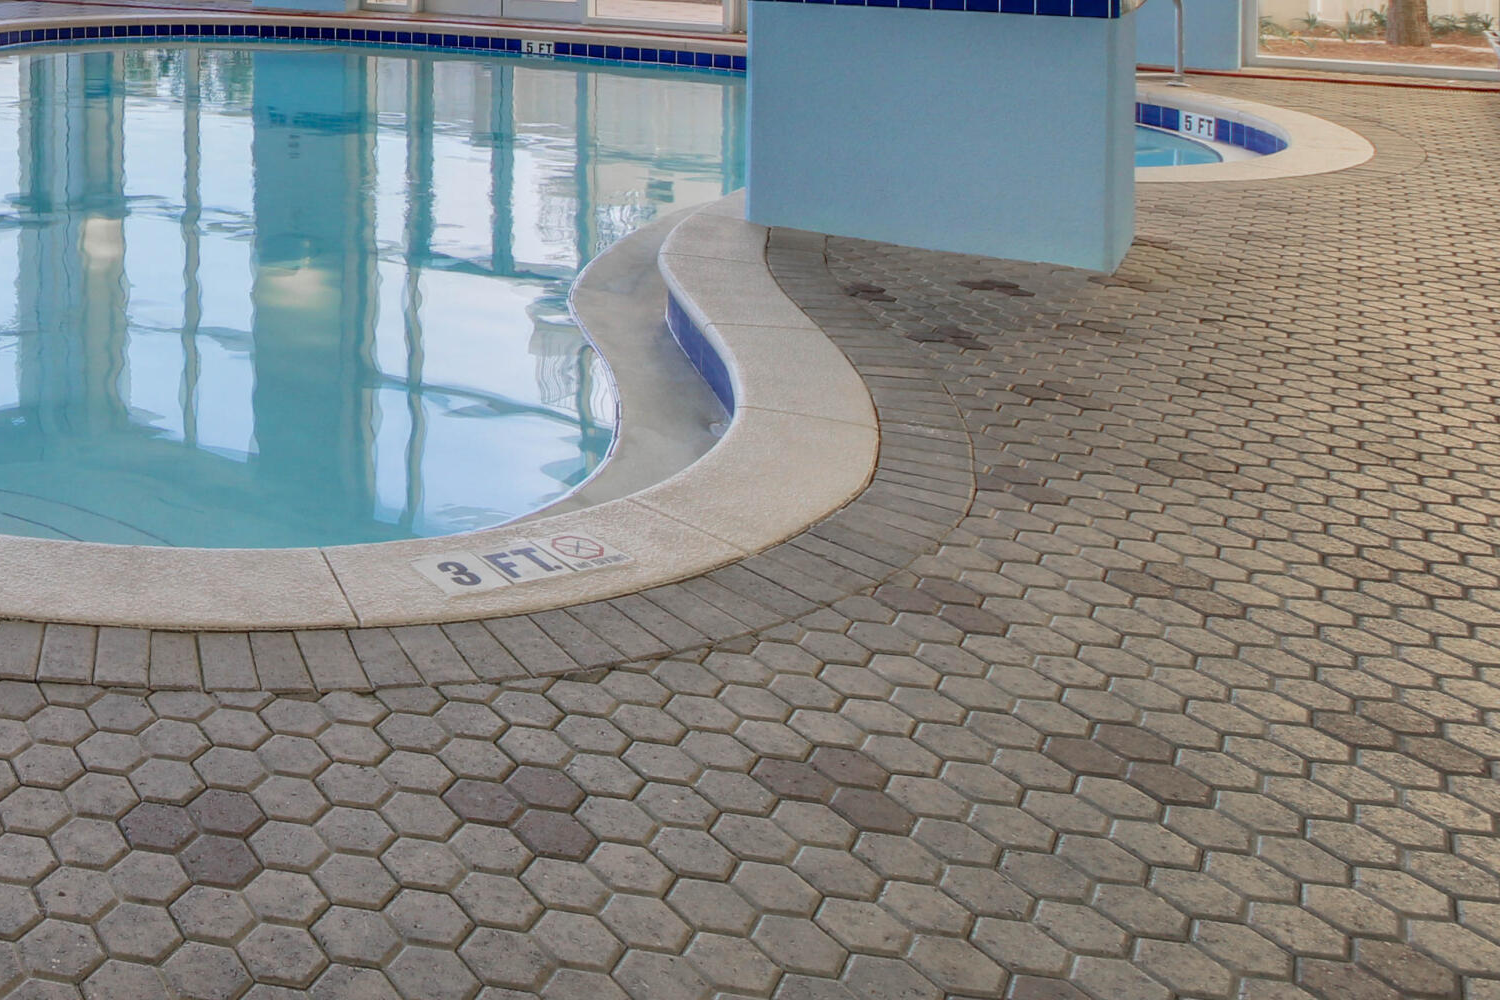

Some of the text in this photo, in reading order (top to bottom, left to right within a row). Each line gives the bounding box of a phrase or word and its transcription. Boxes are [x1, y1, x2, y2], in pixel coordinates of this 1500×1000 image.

[526, 42, 533, 53] 5
[1184, 115, 1193, 131] 5
[437, 547, 563, 586] 3 FT.
